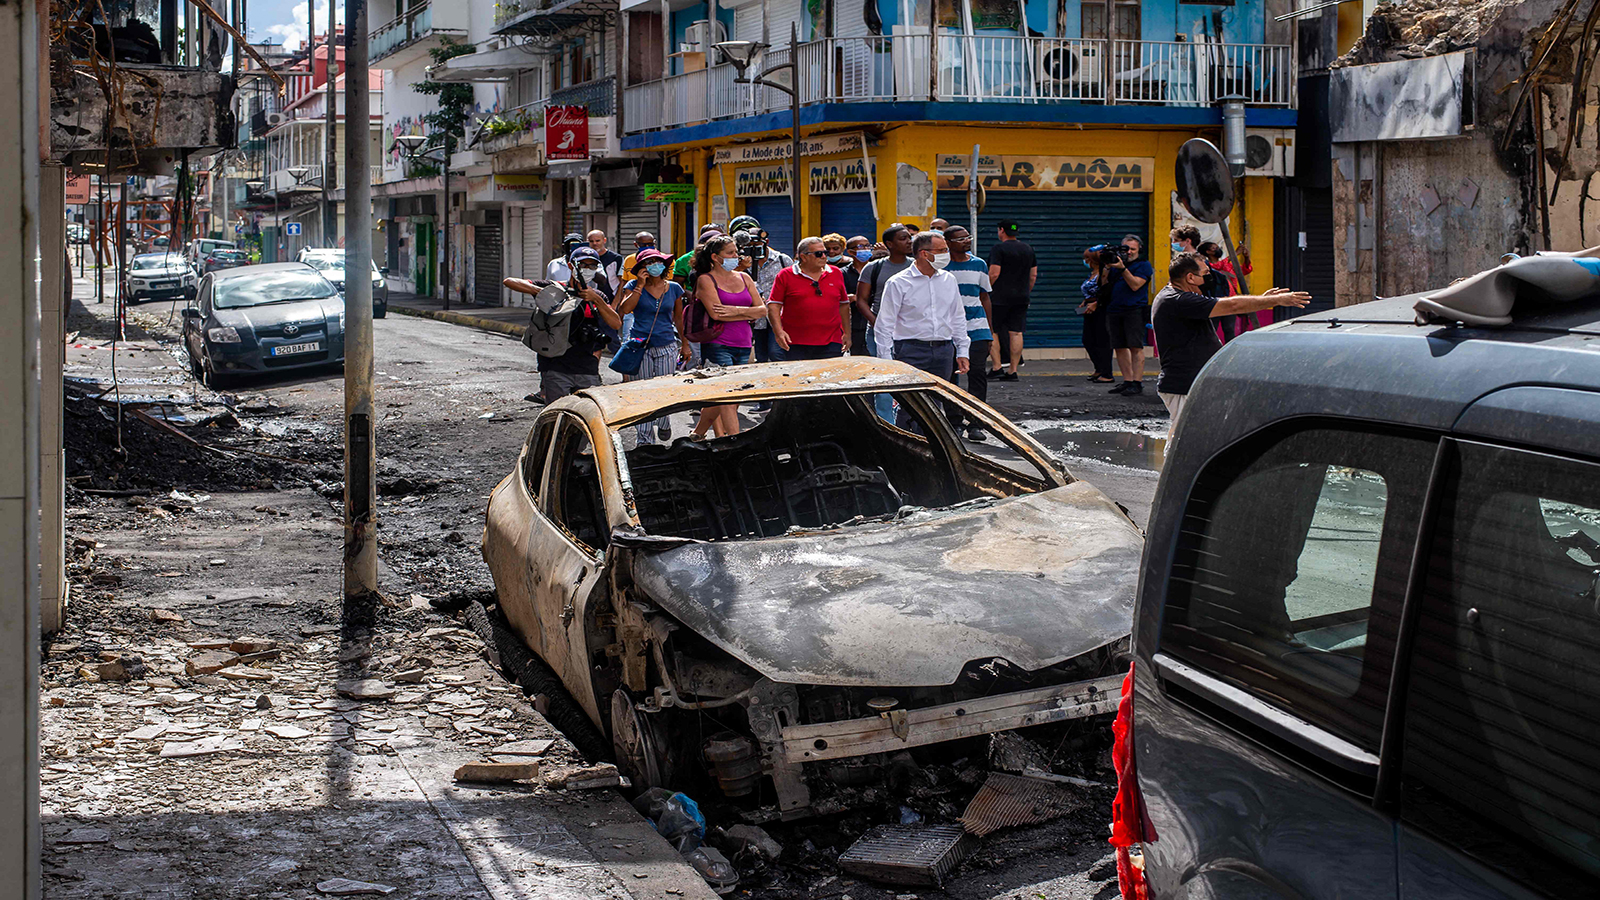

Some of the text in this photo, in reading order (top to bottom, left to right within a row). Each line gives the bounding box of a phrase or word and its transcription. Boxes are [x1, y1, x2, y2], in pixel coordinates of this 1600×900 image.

[742, 148, 750, 159] La
[751, 146, 772, 158] Mode
[774, 146, 784, 156] de
[809, 142, 823, 152] ans
[944, 155, 962, 165] Ria
[978, 155, 994, 165] Ria
[810, 166, 838, 193] STAR
[1055, 158, 1142, 189] MÔM
[496, 183, 539, 191] Primavera
[738, 172, 762, 195] STAR
[276, 347, 291, 355] 920
[292, 344, 306, 352] BAF
